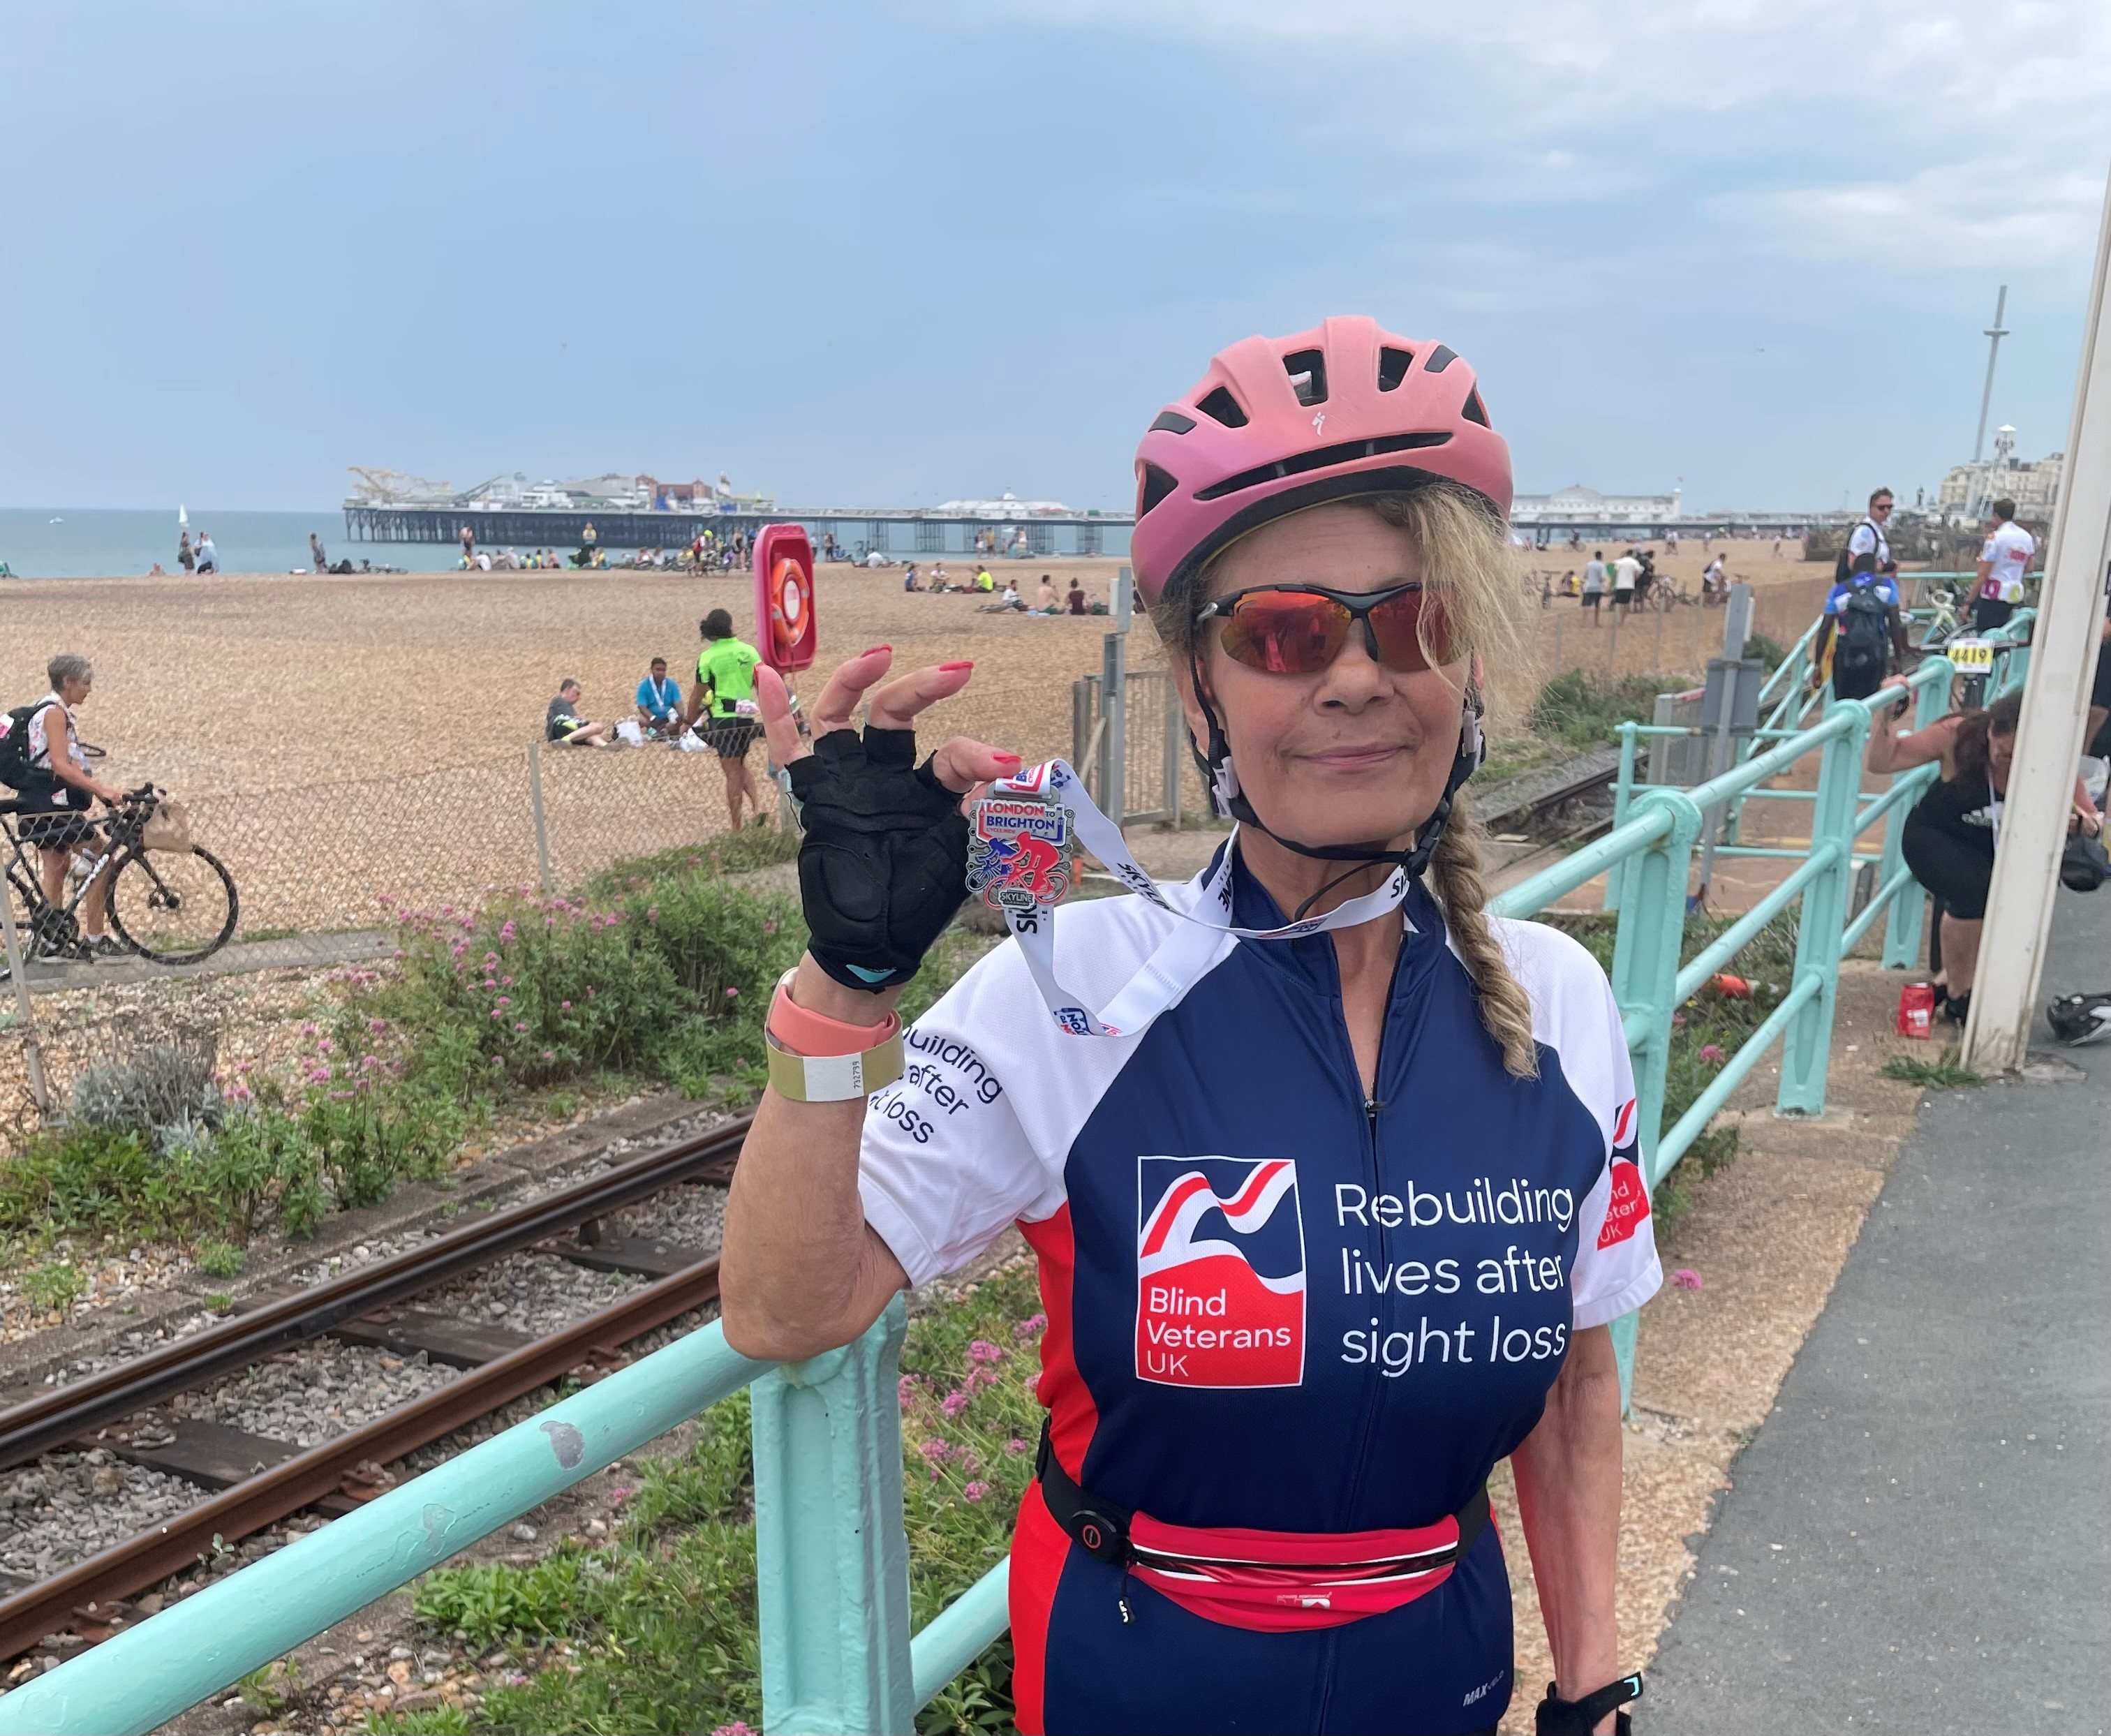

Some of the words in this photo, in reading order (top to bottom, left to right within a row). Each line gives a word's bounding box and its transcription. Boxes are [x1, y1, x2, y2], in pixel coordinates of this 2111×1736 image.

[986, 802, 1045, 817] LONDON
[986, 815, 1055, 830] BRIGHTON
[1001, 892, 1032, 903] SKYLINE
[909, 1064, 969, 1115] after
[882, 1092, 934, 1143] loss
[1334, 1177, 1573, 1233] Rebuilding
[1600, 1222, 1623, 1242] UK
[1341, 1247, 1460, 1295] lives
[1475, 1245, 1564, 1293] after
[1149, 1286, 1227, 1316] Blind
[1146, 1319, 1291, 1349] Veterans
[1340, 1317, 1474, 1378] sight
[1490, 1314, 1566, 1363] loss
[1146, 1353, 1190, 1378] UK
